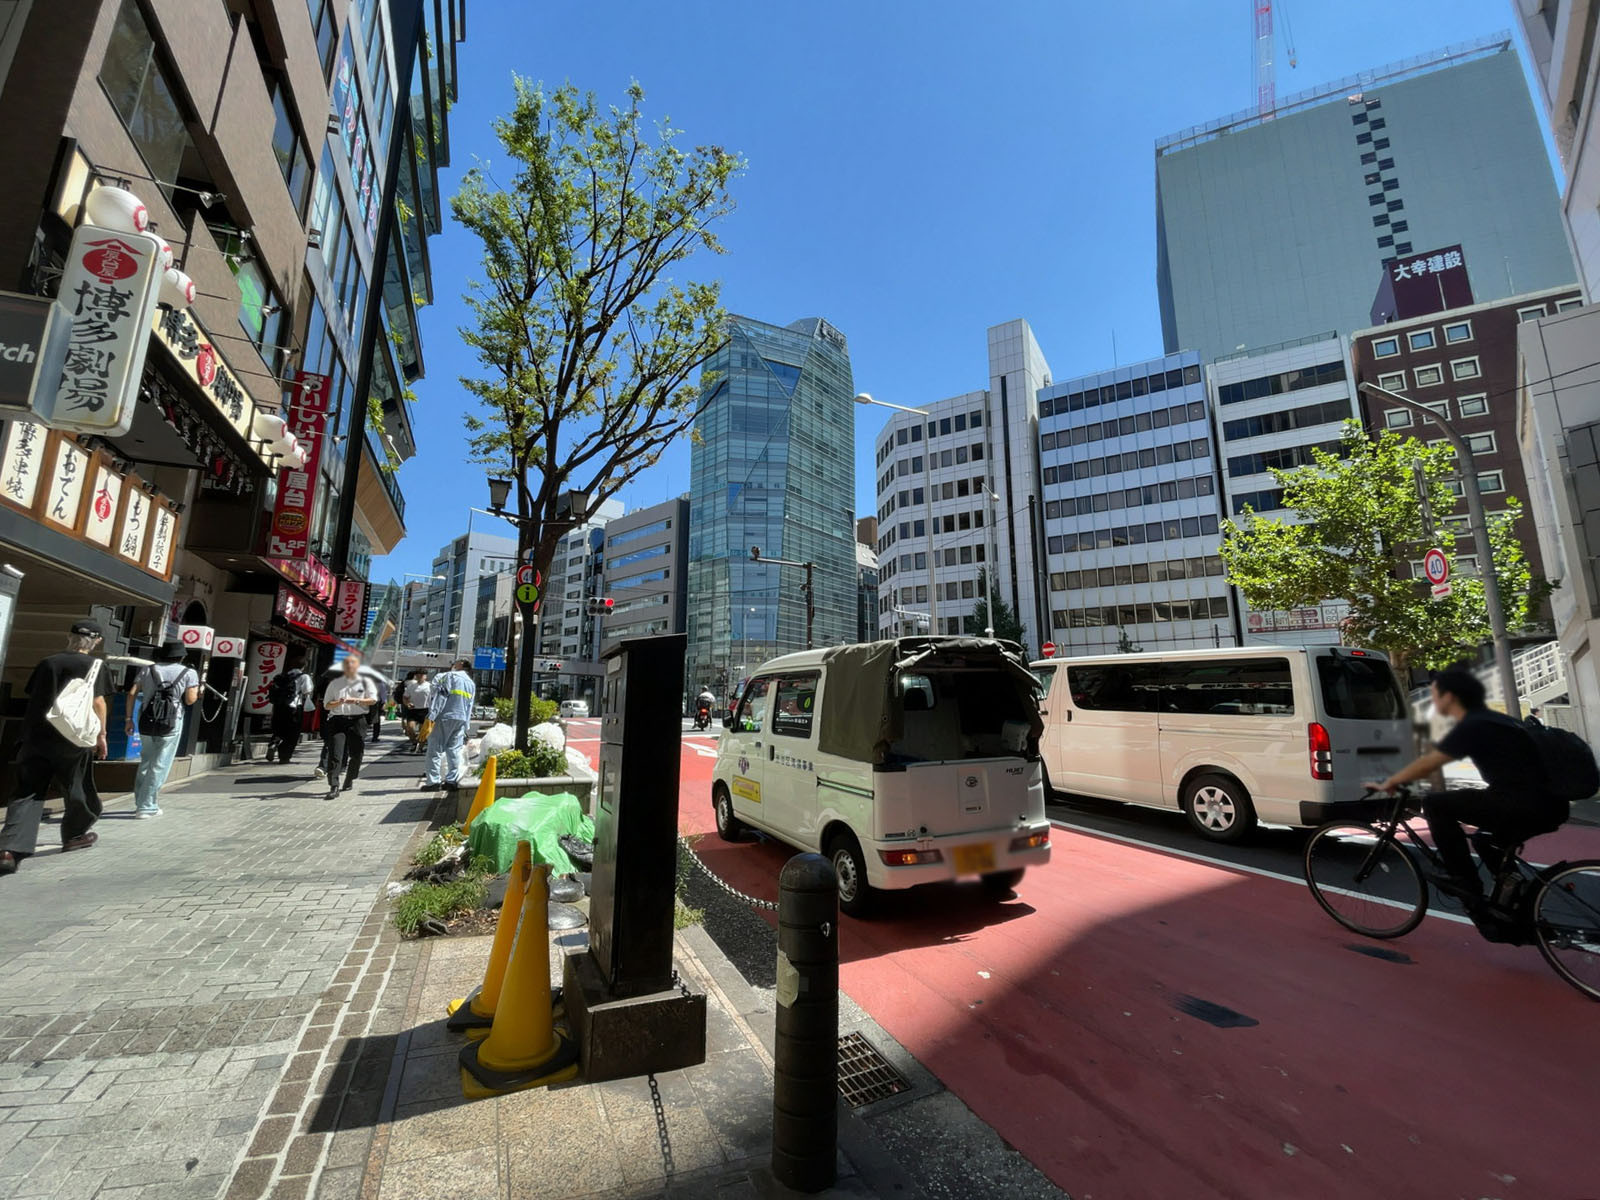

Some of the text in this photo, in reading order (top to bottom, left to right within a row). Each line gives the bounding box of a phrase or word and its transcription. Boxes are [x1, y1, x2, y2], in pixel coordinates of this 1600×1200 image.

[1394, 251, 1462, 282] 大幸建設
[59, 280, 134, 412] 博多劇場
[52, 448, 77, 520] おでん
[287, 540, 306, 549] 2F
[1430, 559, 1443, 575] 40
[341, 594, 357, 631] ラーメン
